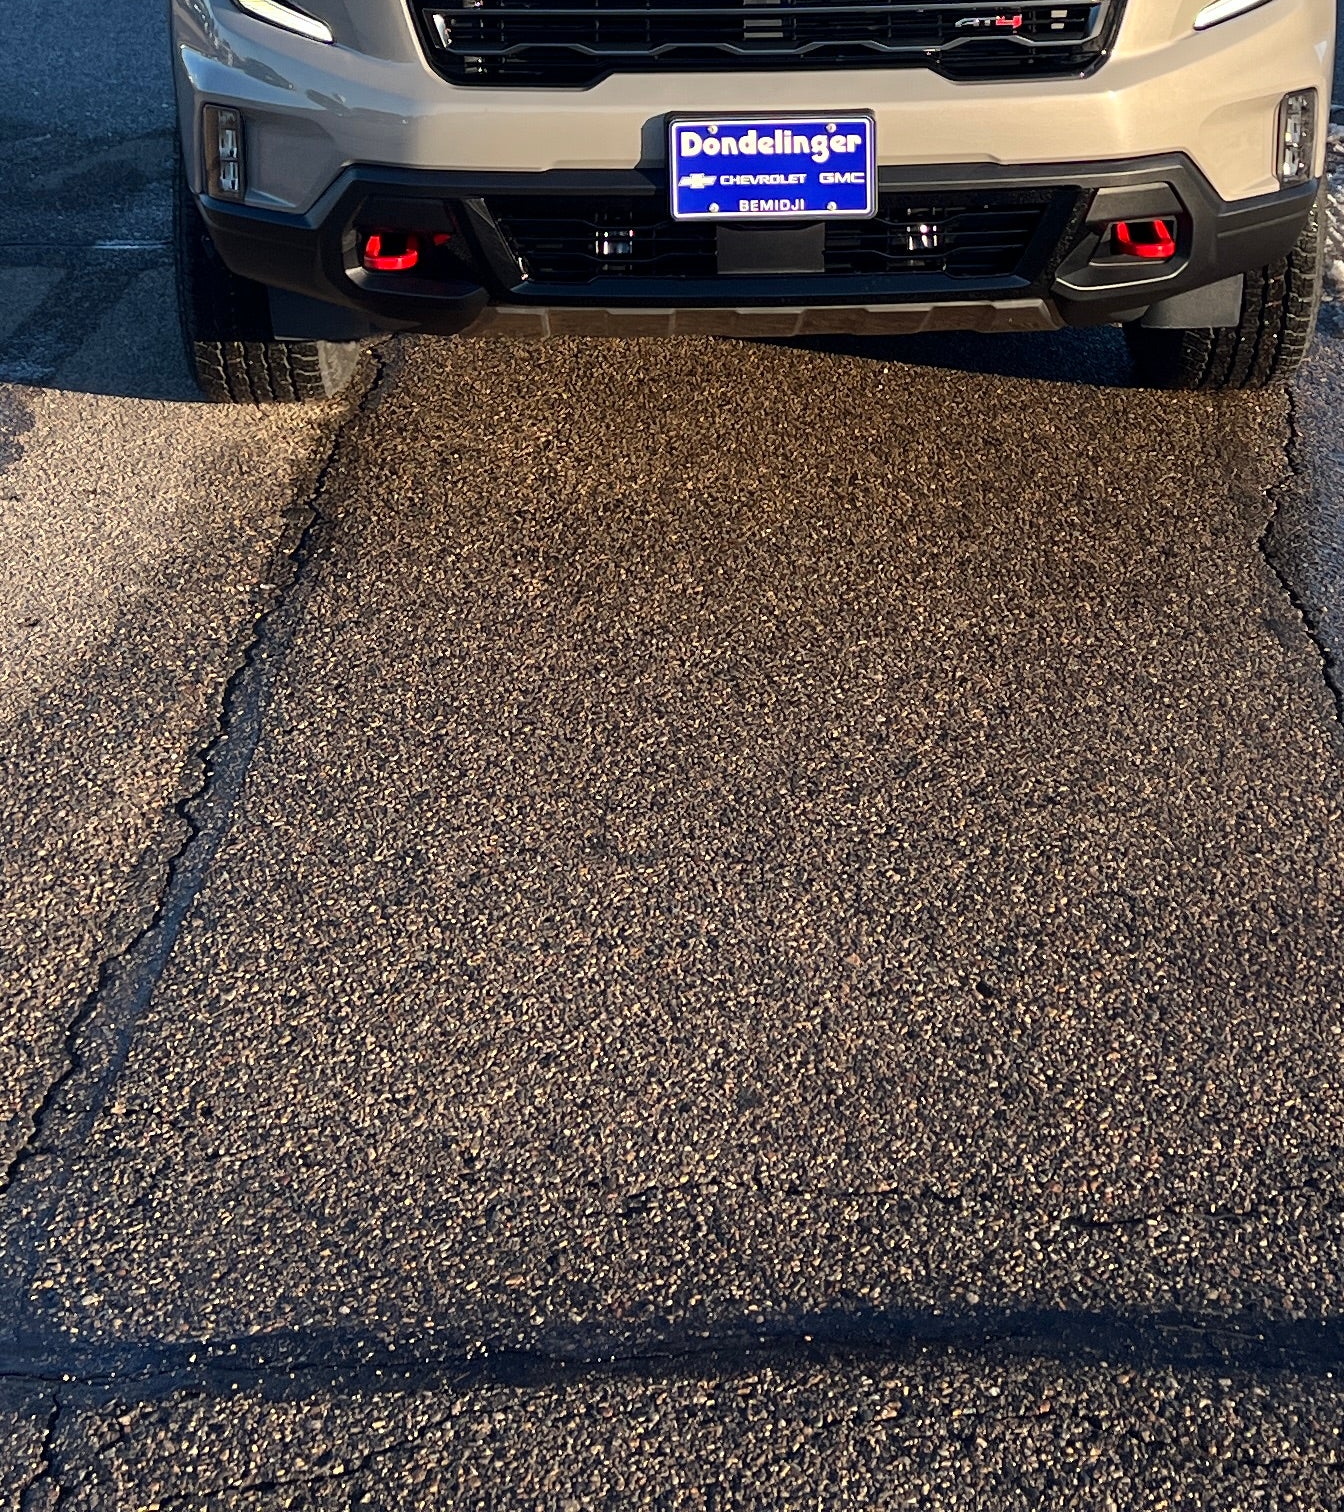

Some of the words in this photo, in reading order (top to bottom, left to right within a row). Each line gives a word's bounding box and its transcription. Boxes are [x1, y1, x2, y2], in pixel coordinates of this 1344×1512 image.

[954, 14, 1023, 29] AT4
[680, 129, 862, 164] Dondelinger
[720, 173, 807, 185] CHEVROLET
[819, 172, 865, 184] GMC
[739, 198, 805, 212] BEMIDJI
